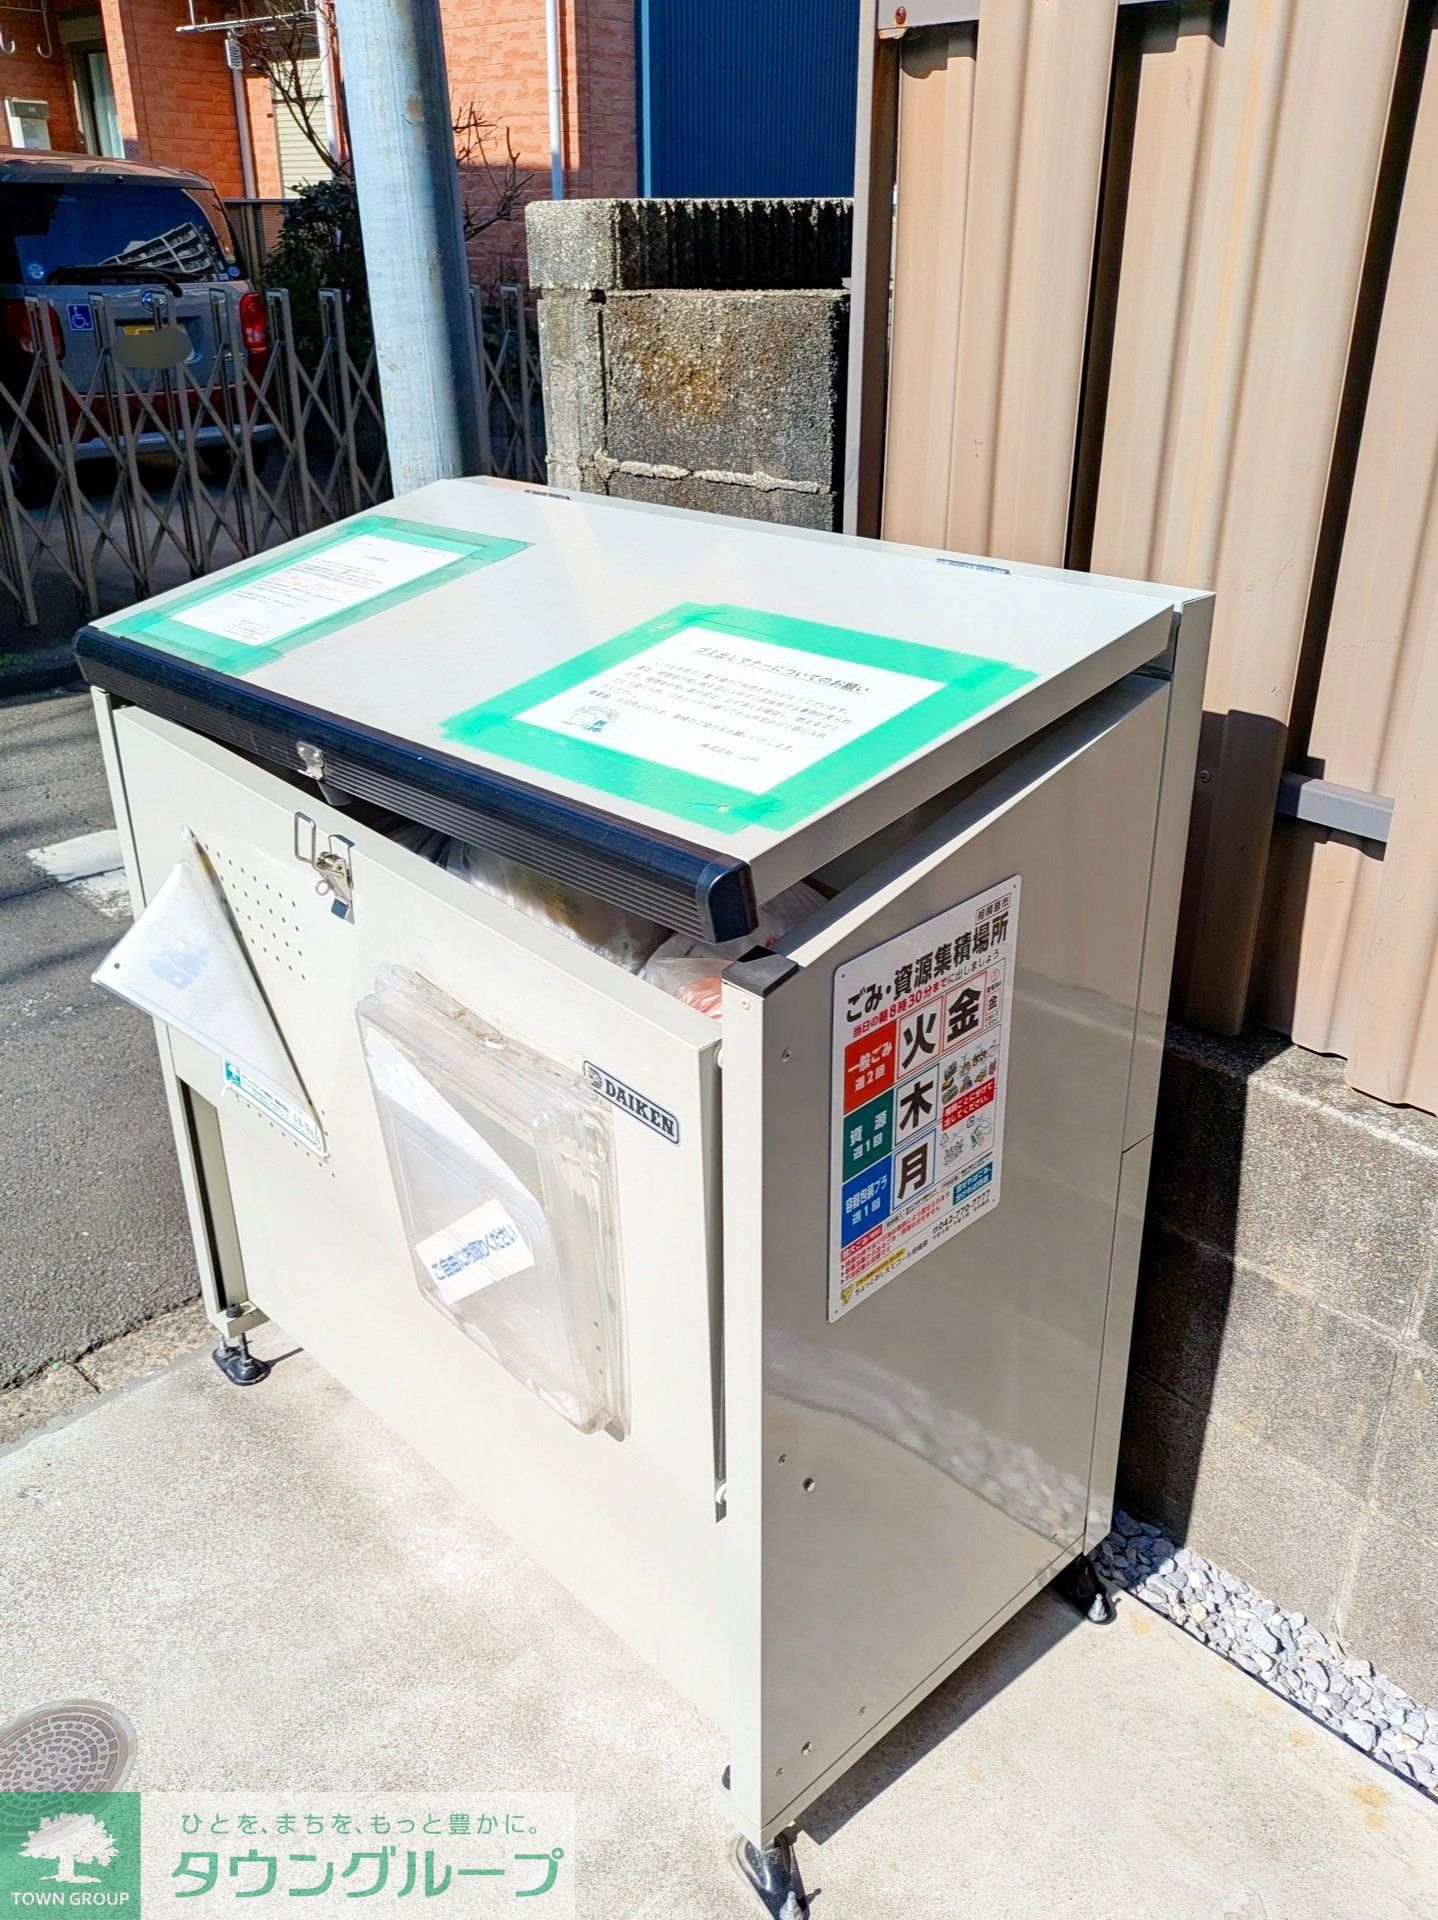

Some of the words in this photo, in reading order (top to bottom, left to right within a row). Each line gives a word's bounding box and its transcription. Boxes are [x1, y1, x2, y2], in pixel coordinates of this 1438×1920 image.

[691, 645, 875, 694] ゴミ出しマナーについてのお願い
[847, 911, 1009, 1023] ごみ・資源集積場所
[853, 949, 999, 1038] 当日の朝8時30分までに出しましょう
[848, 1041, 892, 1073] 一般ごみ
[902, 1013, 936, 1069] 火
[947, 987, 981, 1043] 金
[604, 1078, 674, 1137] DAIKEN
[899, 1078, 934, 1130] 木
[852, 1132, 883, 1161] 週1回
[897, 1142, 928, 1200] 月
